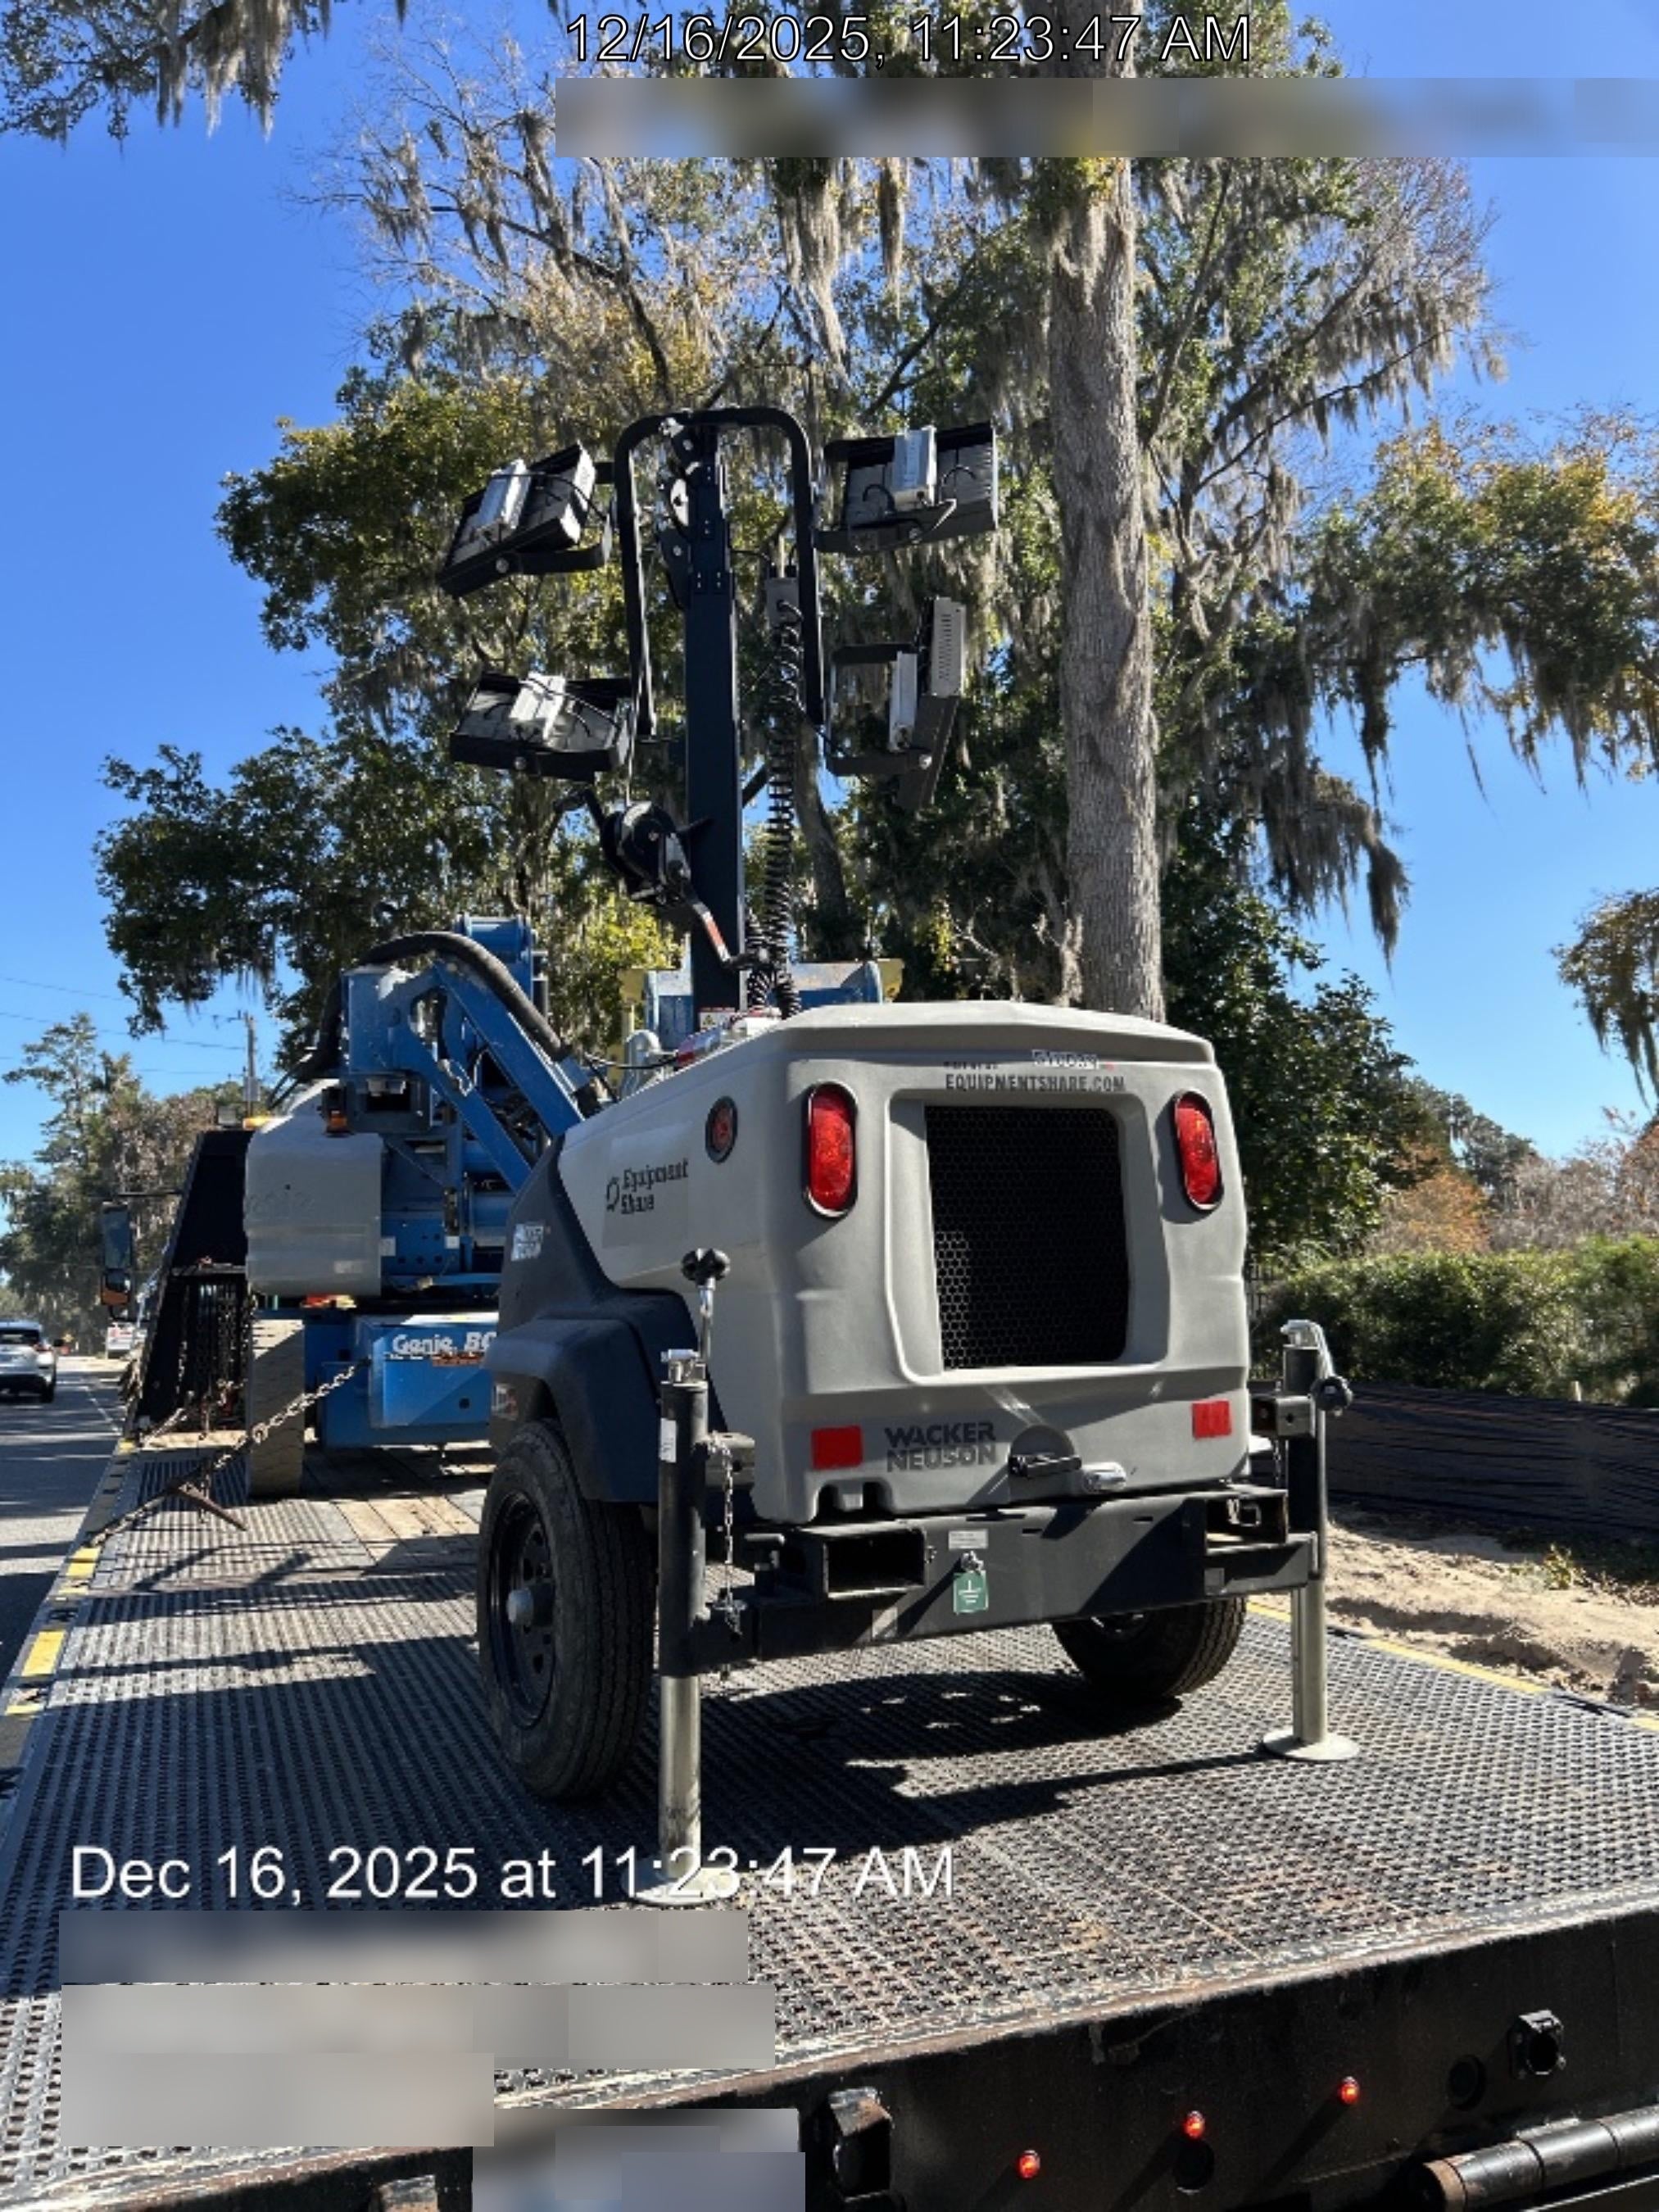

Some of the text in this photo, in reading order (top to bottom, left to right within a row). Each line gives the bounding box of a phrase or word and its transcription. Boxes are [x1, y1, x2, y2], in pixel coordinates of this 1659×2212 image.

[623, 1157, 689, 1192] Equipment
[392, 1333, 453, 1355] Genie
[884, 1421, 997, 1448] WACKER
[886, 1446, 996, 1471] NEUSON
